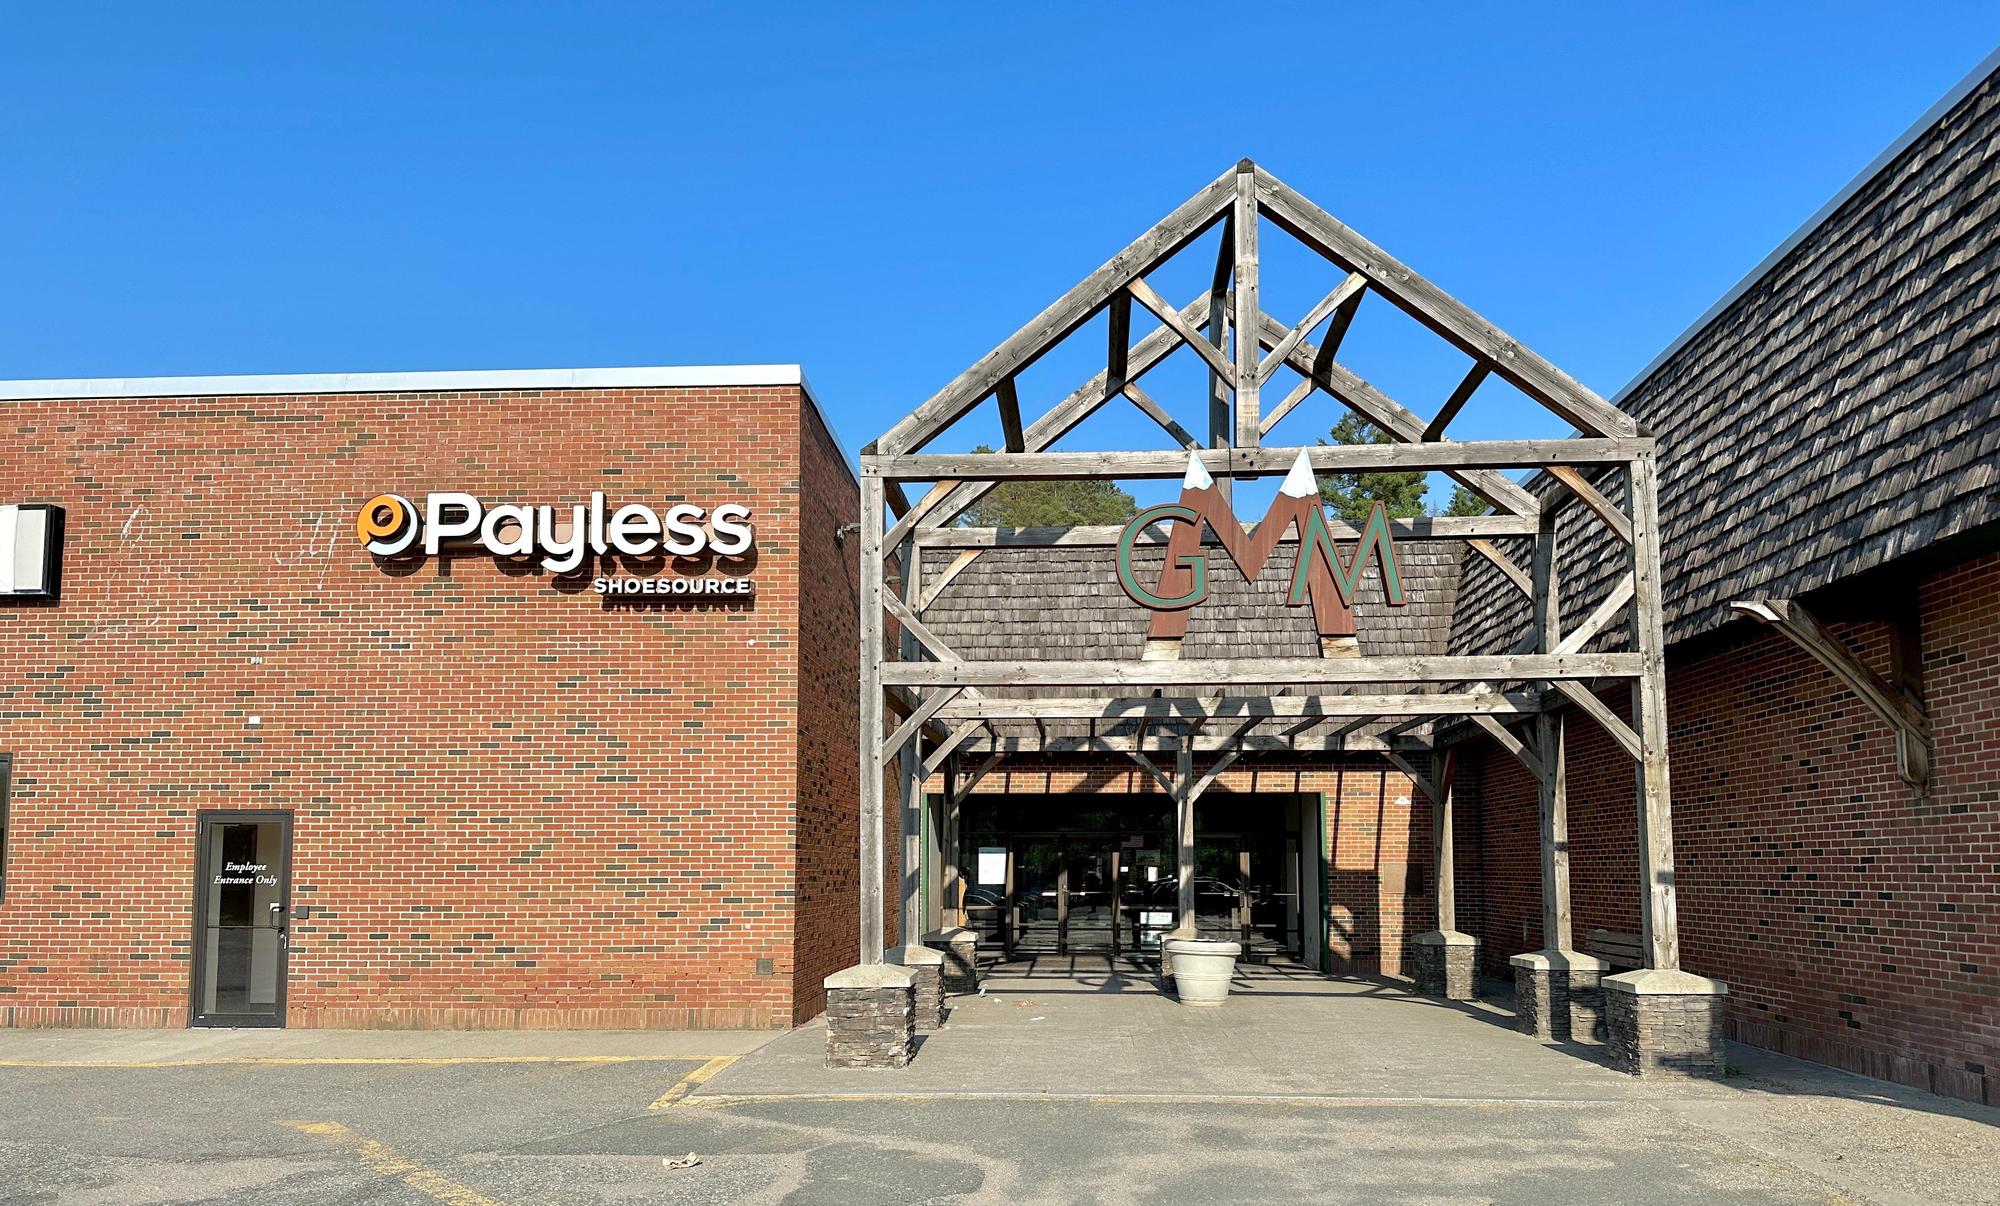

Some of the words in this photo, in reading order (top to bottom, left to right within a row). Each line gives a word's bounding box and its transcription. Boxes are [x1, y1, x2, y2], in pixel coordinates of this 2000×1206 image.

[425, 491, 752, 573] Payless
[593, 577, 751, 595] SHOESOURCE
[225, 861, 267, 874] Employee
[214, 875, 254, 885] Entrance
[255, 874, 278, 887] Only
